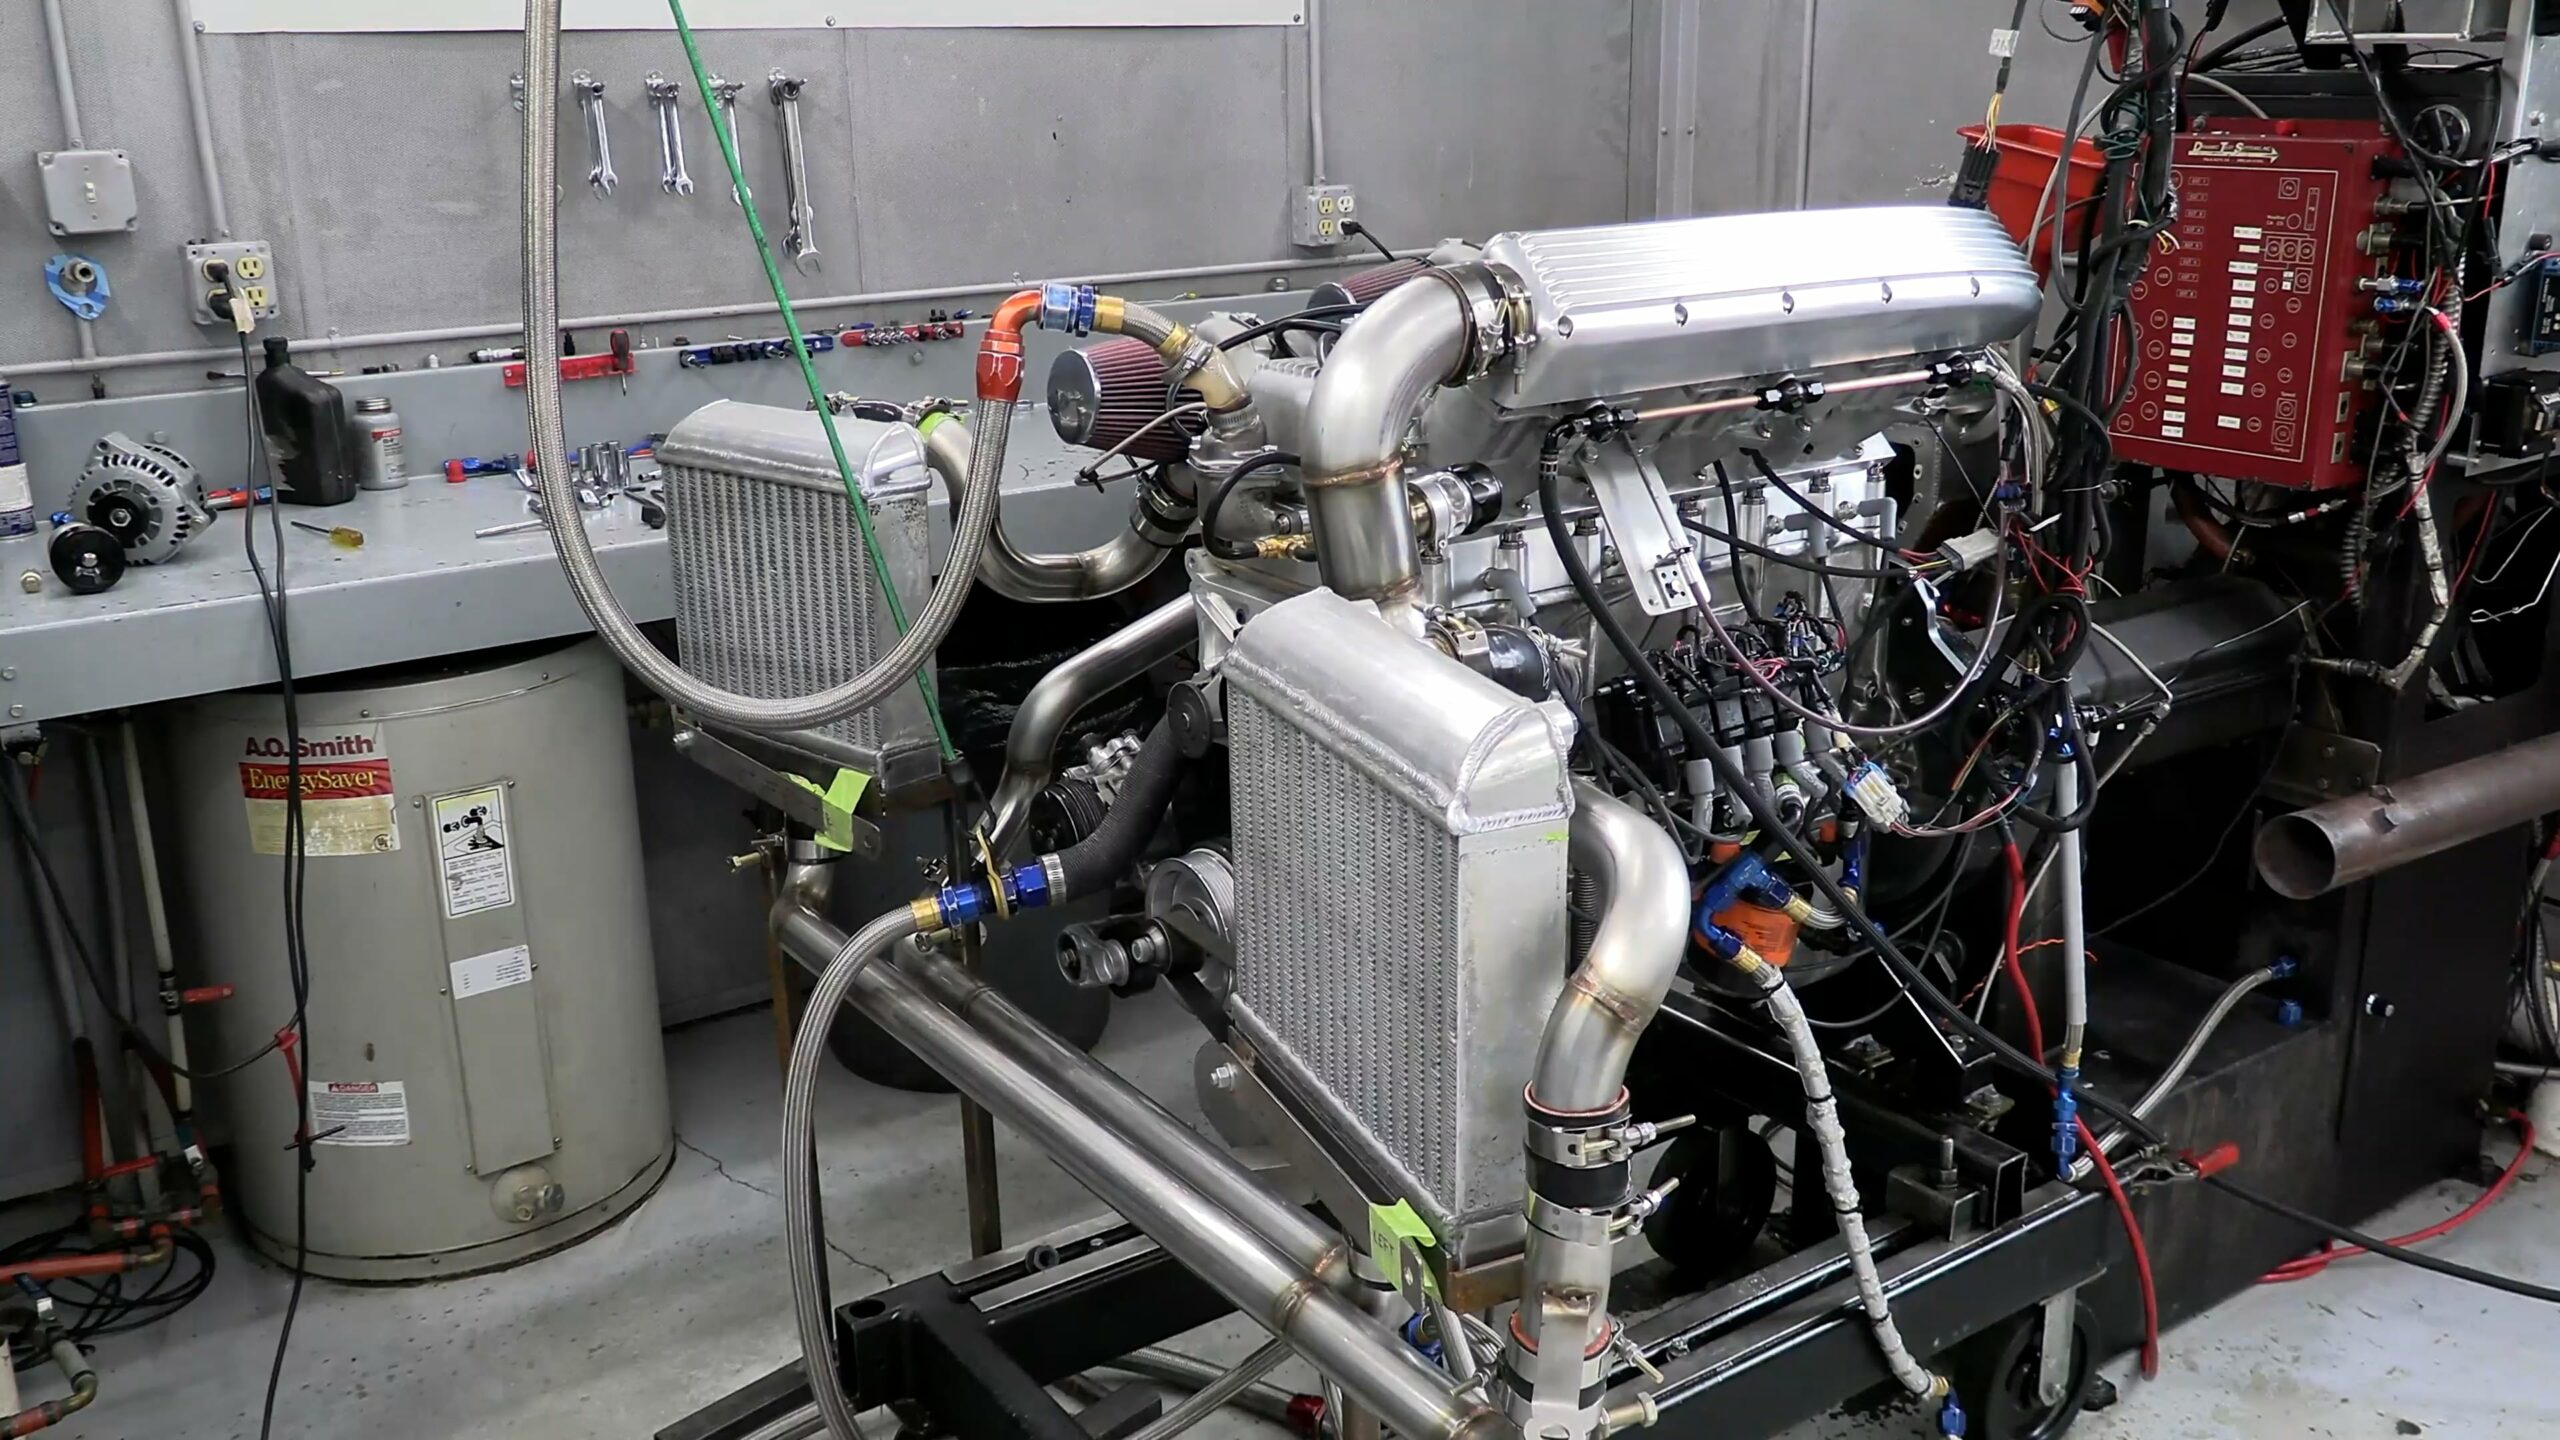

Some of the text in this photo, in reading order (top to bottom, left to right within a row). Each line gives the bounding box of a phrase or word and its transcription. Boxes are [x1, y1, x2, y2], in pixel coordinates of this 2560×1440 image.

[245, 734, 374, 757] A.O. Smith
[248, 767, 376, 794] EnegySaver
[338, 1084, 377, 1093] DANGER
[1373, 1230, 1395, 1255] LEFT
